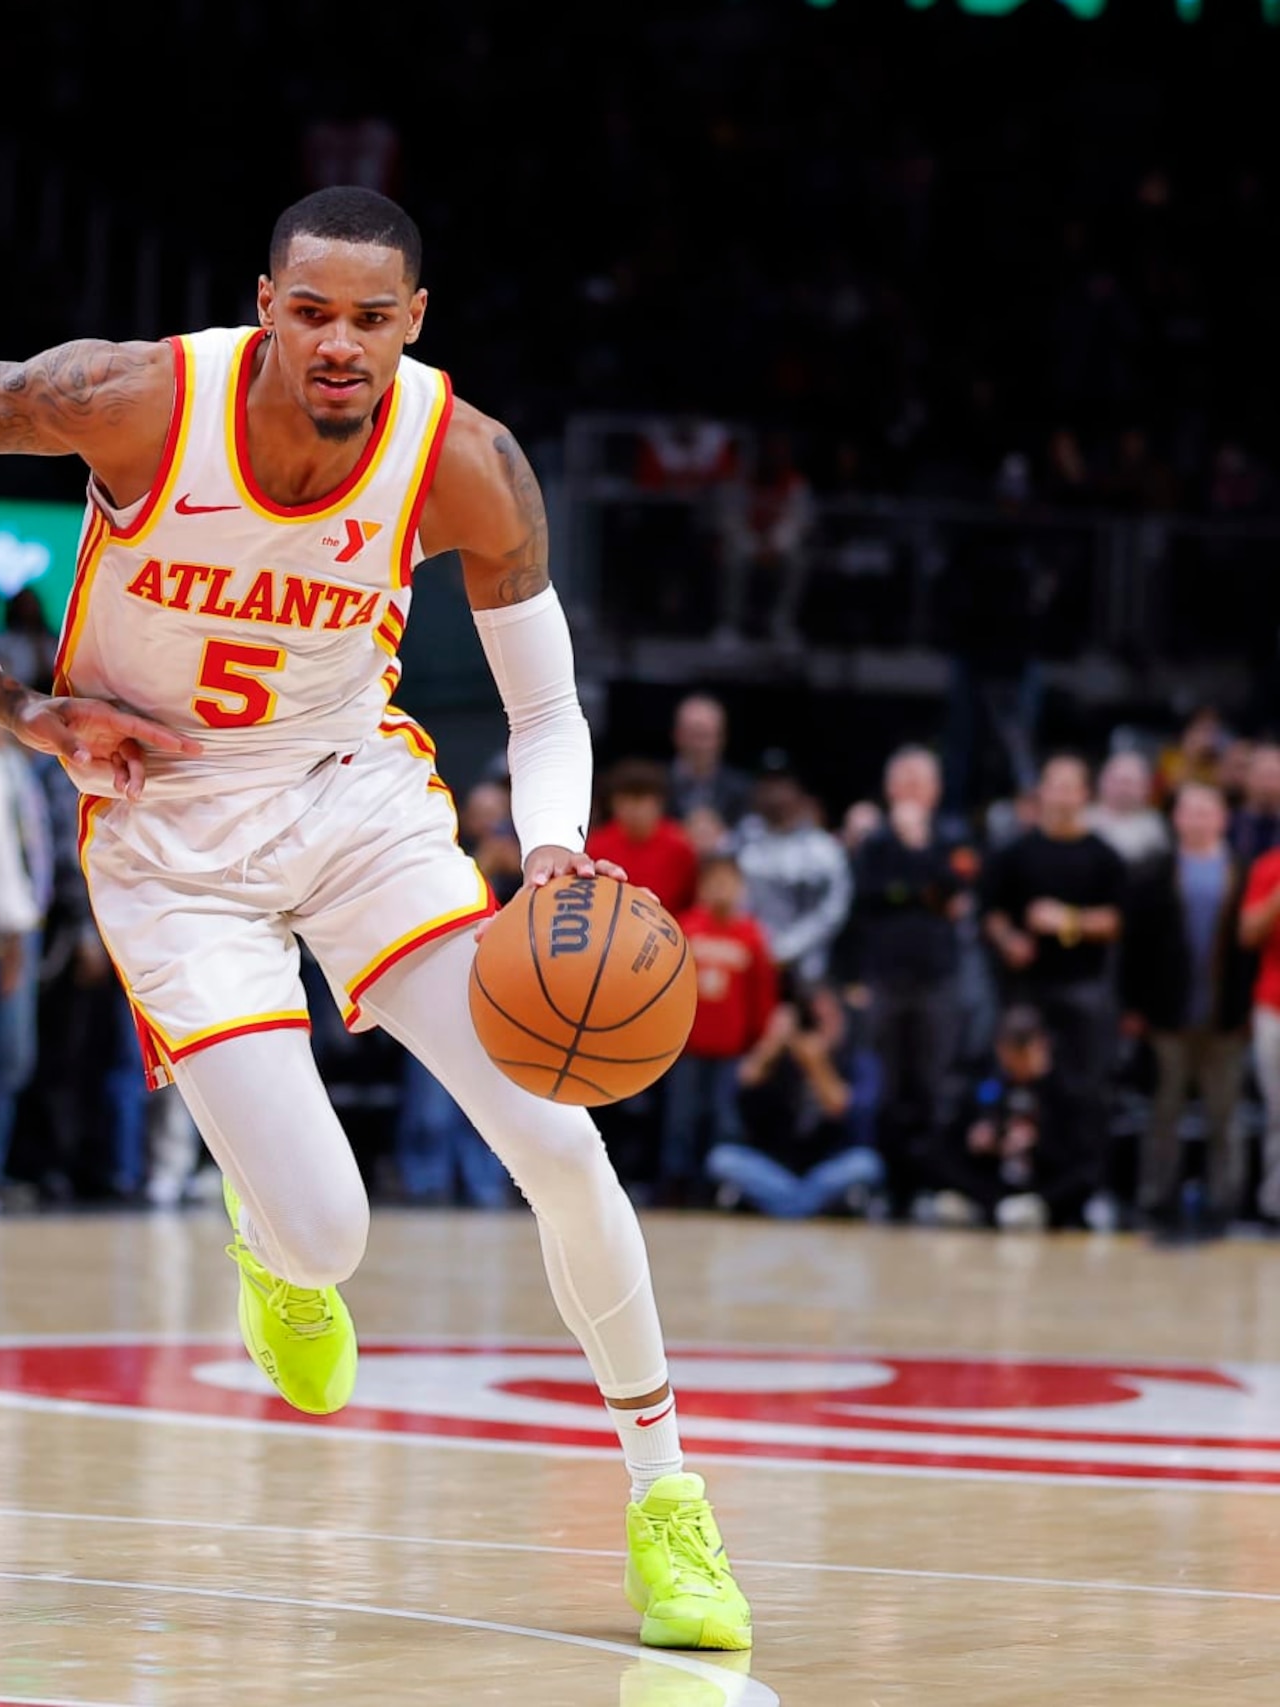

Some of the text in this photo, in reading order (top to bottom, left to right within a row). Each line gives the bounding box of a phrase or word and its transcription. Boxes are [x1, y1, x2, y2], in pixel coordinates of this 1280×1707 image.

[321, 536, 340, 547] the
[125, 557, 383, 631] ATLANTA
[191, 636, 288, 730] 5
